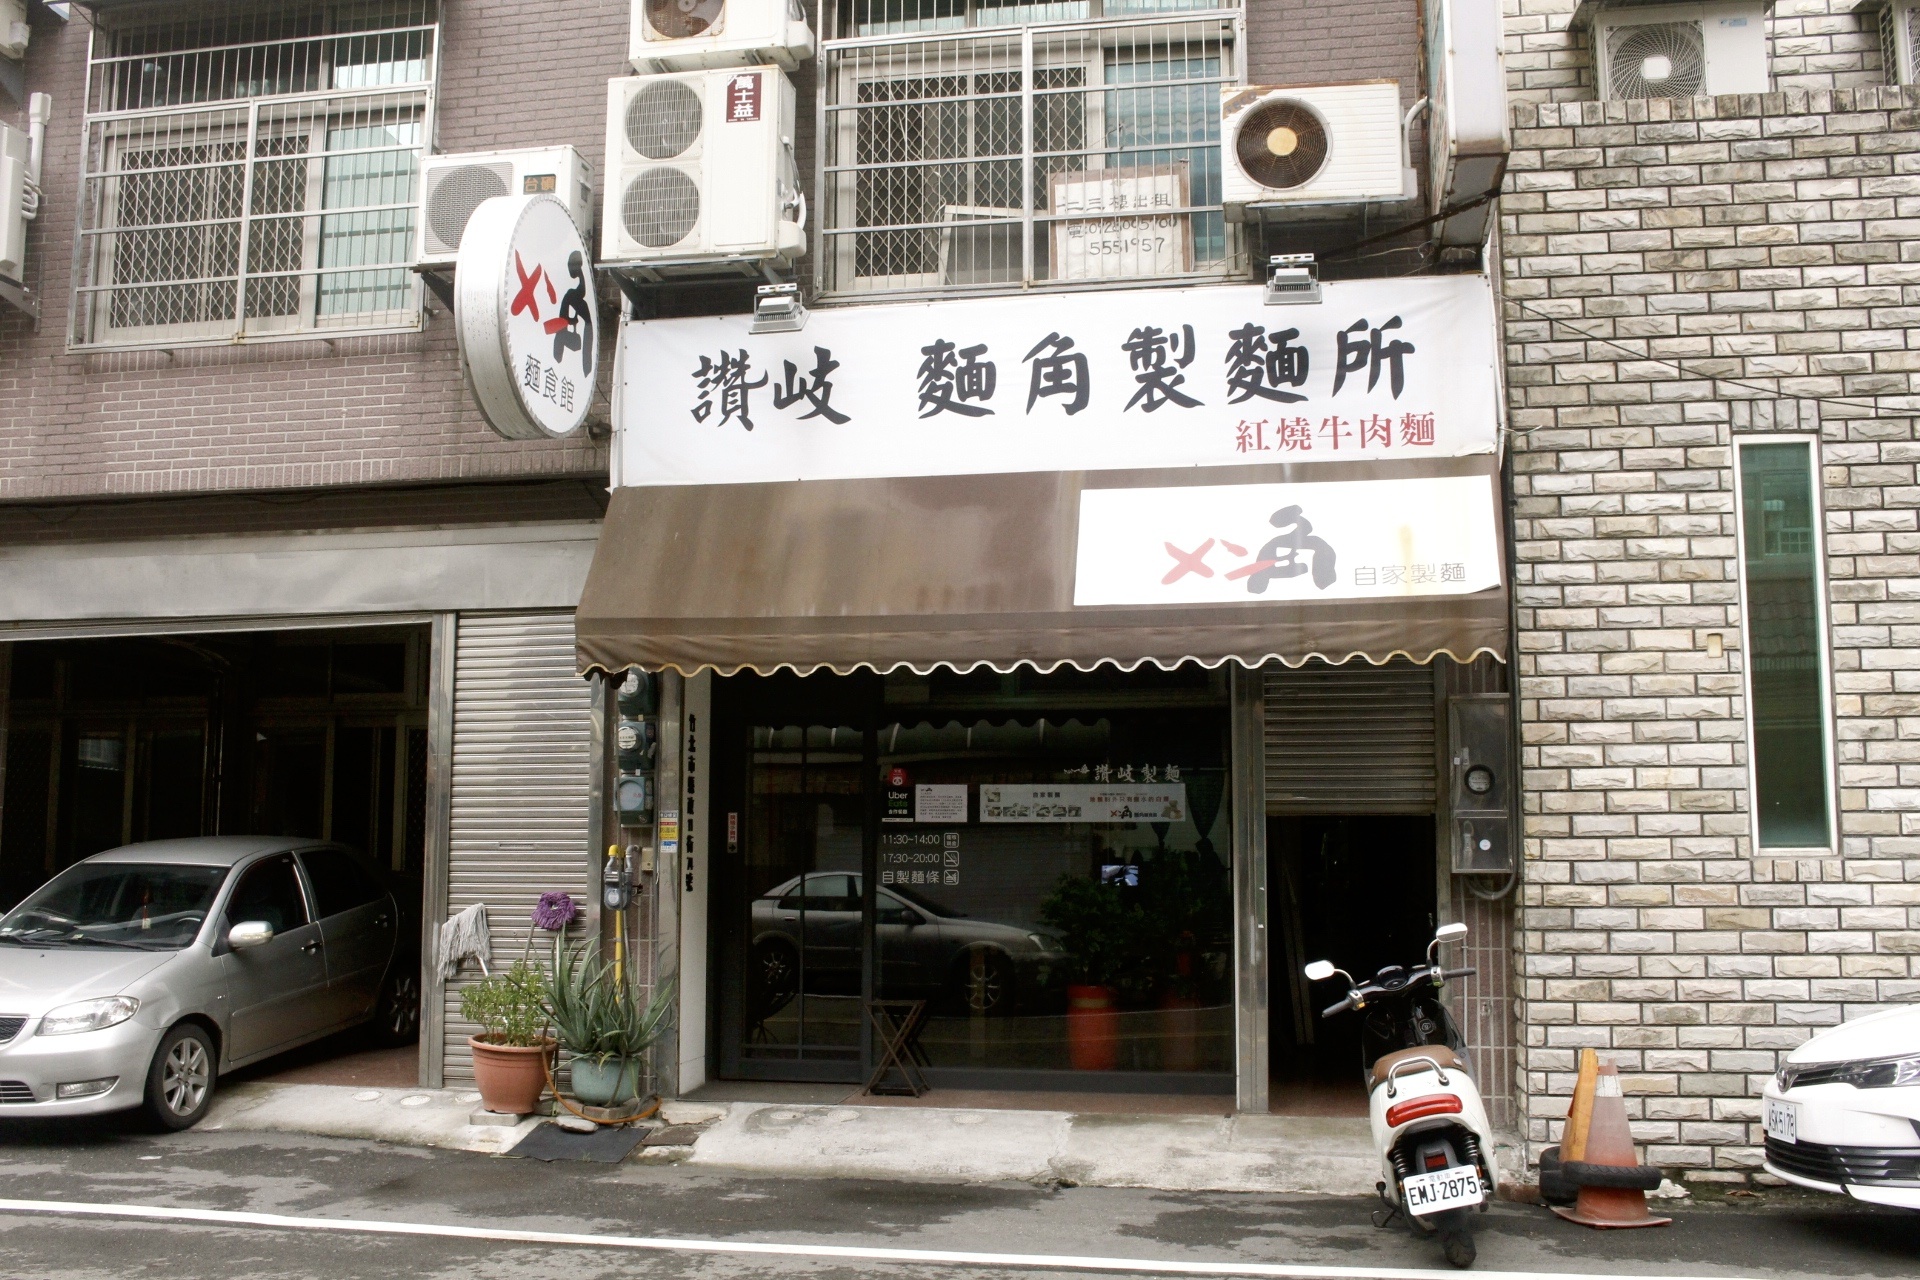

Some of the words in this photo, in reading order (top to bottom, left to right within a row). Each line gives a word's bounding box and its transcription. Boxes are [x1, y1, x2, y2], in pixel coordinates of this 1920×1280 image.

[733, 75, 755, 118] 萬士益
[523, 352, 576, 414] 麵食館
[689, 345, 852, 432] 讚岐
[915, 314, 1416, 420] 麵角製麵所
[1234, 411, 1437, 455] 紅燒牛肉麵
[1353, 561, 1468, 587] 自家製麵
[1094, 763, 1181, 784] 讚岐製麵
[887, 791, 909, 800] Uber
[882, 834, 941, 844] 11:30~14:00
[882, 853, 941, 863] 17:30~20:00
[882, 870, 941, 884] 自製麵條
